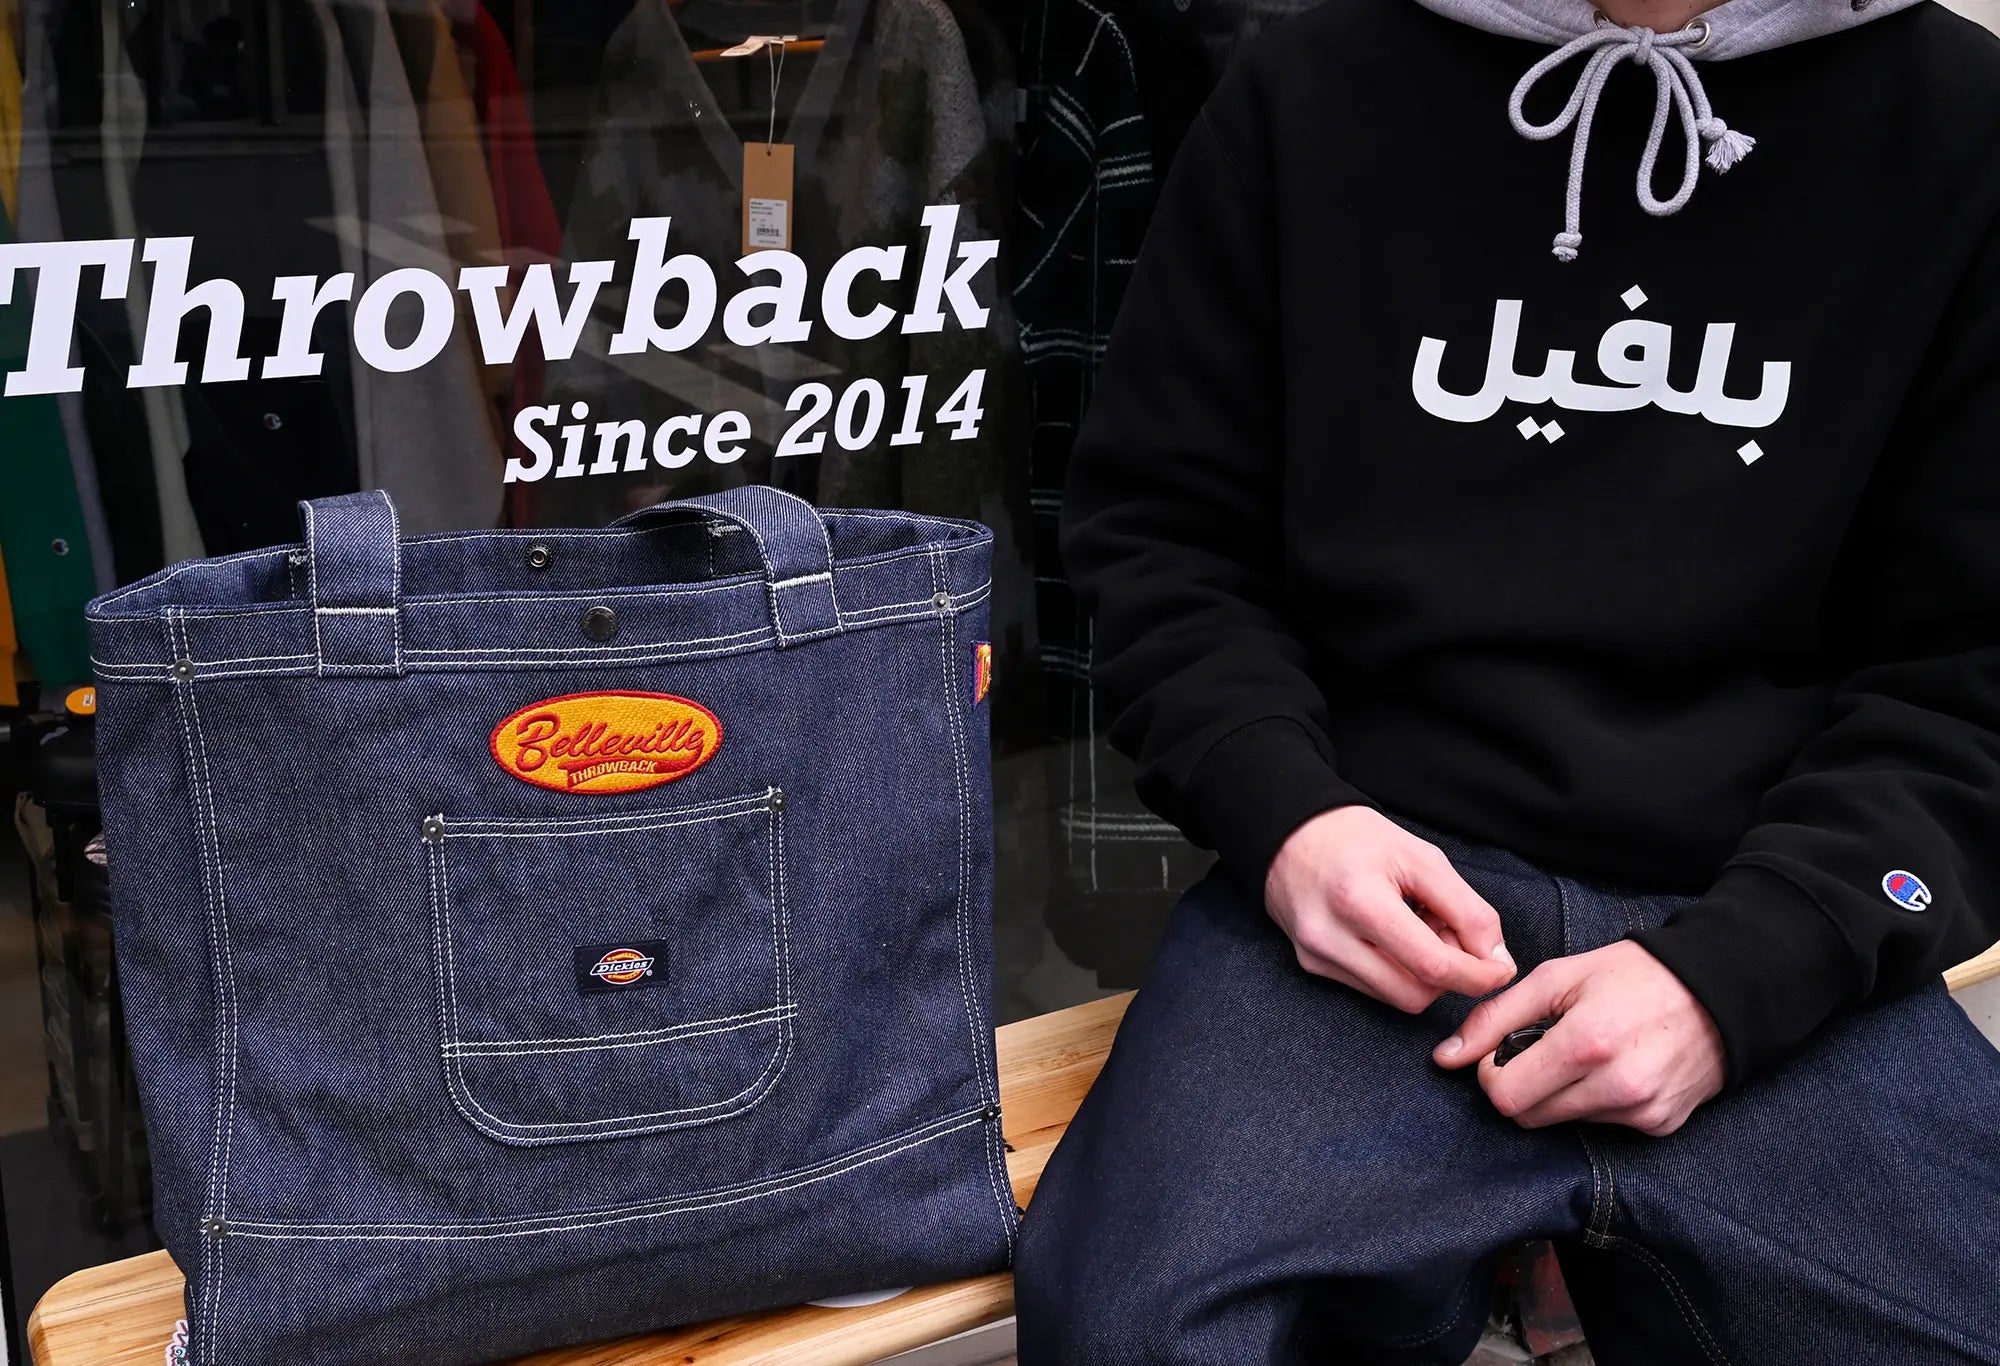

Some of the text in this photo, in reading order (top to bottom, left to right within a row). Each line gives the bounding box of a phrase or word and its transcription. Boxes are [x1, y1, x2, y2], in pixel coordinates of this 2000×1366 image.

[0, 205, 1000, 396] Throwback
[1412, 284, 1793, 466] بلفيل
[503, 369, 987, 484] Since 2014
[516, 712, 704, 772] Belleville
[569, 759, 658, 785] THROWBACK
[597, 961, 648, 973] Dickies
